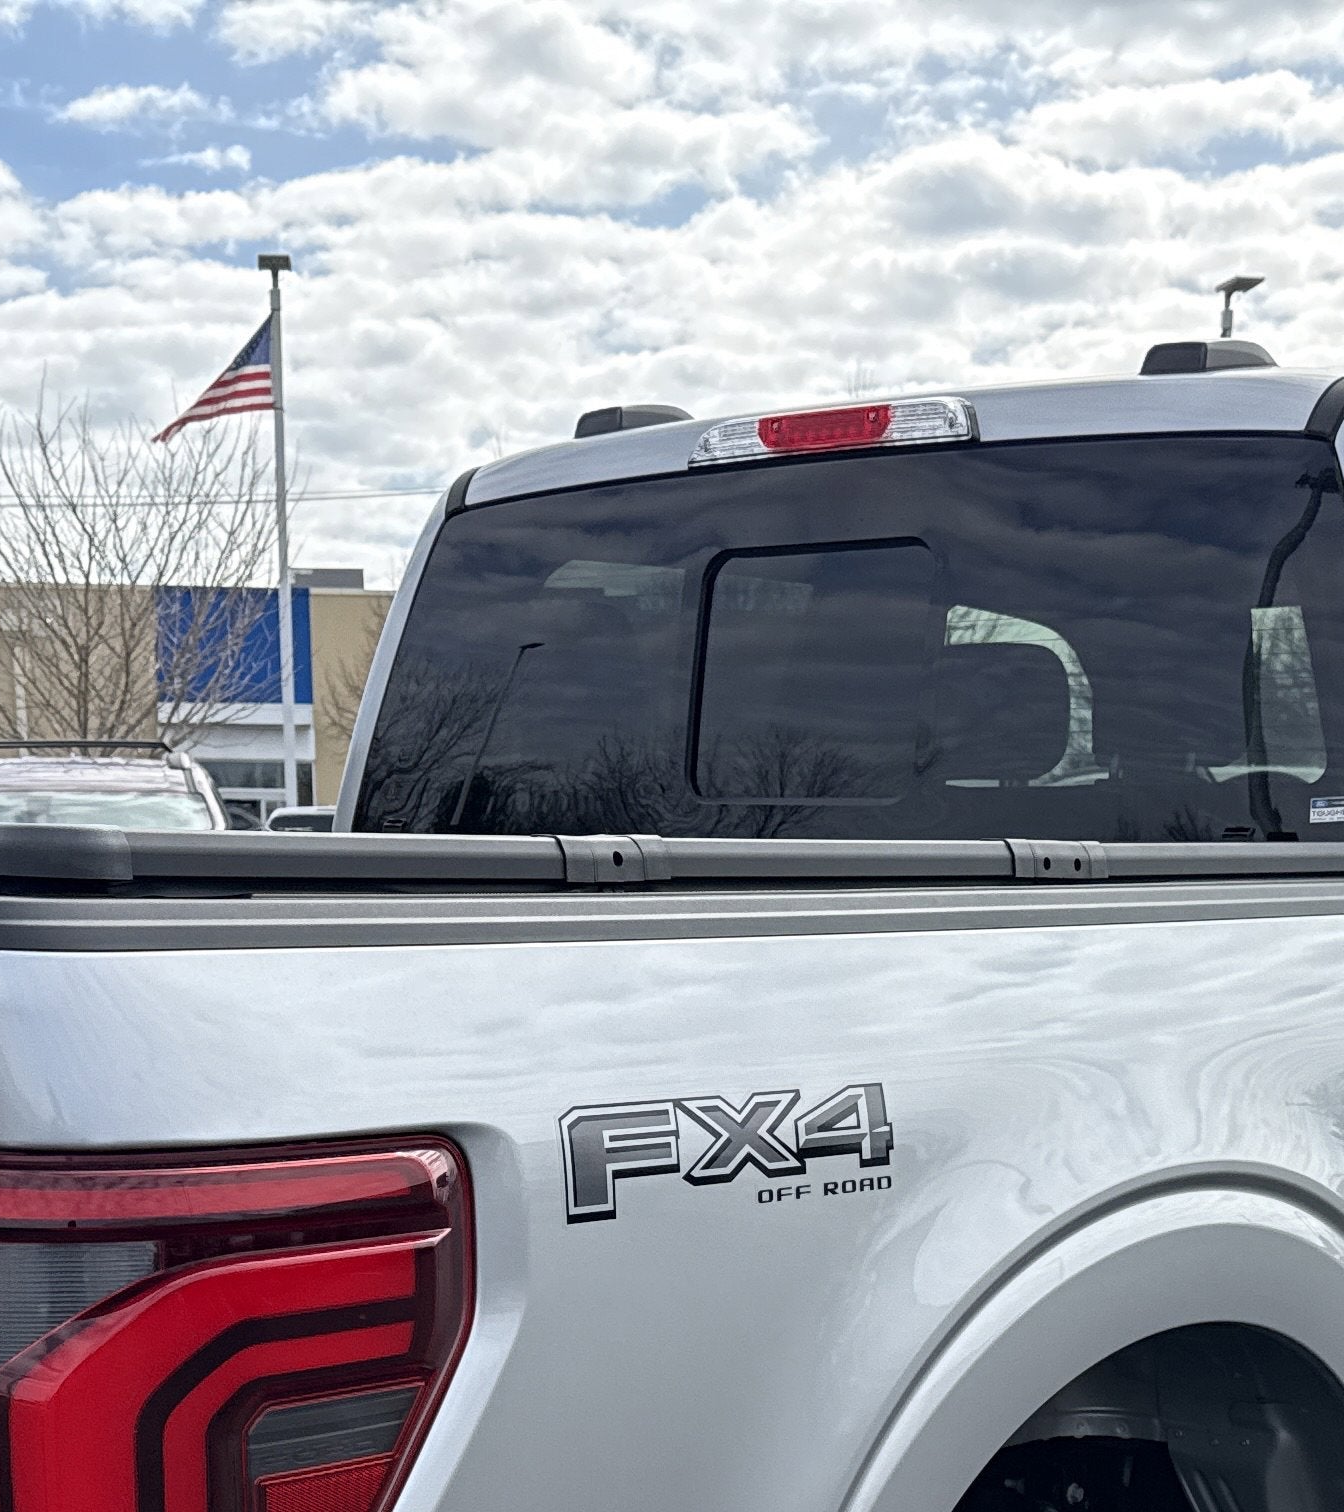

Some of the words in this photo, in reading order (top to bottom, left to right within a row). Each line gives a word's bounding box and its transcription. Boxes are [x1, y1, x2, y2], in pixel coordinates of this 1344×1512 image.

[558, 1082, 895, 1225] FX4
[757, 1183, 811, 1205] OFF
[823, 1175, 893, 1197] ROAD
